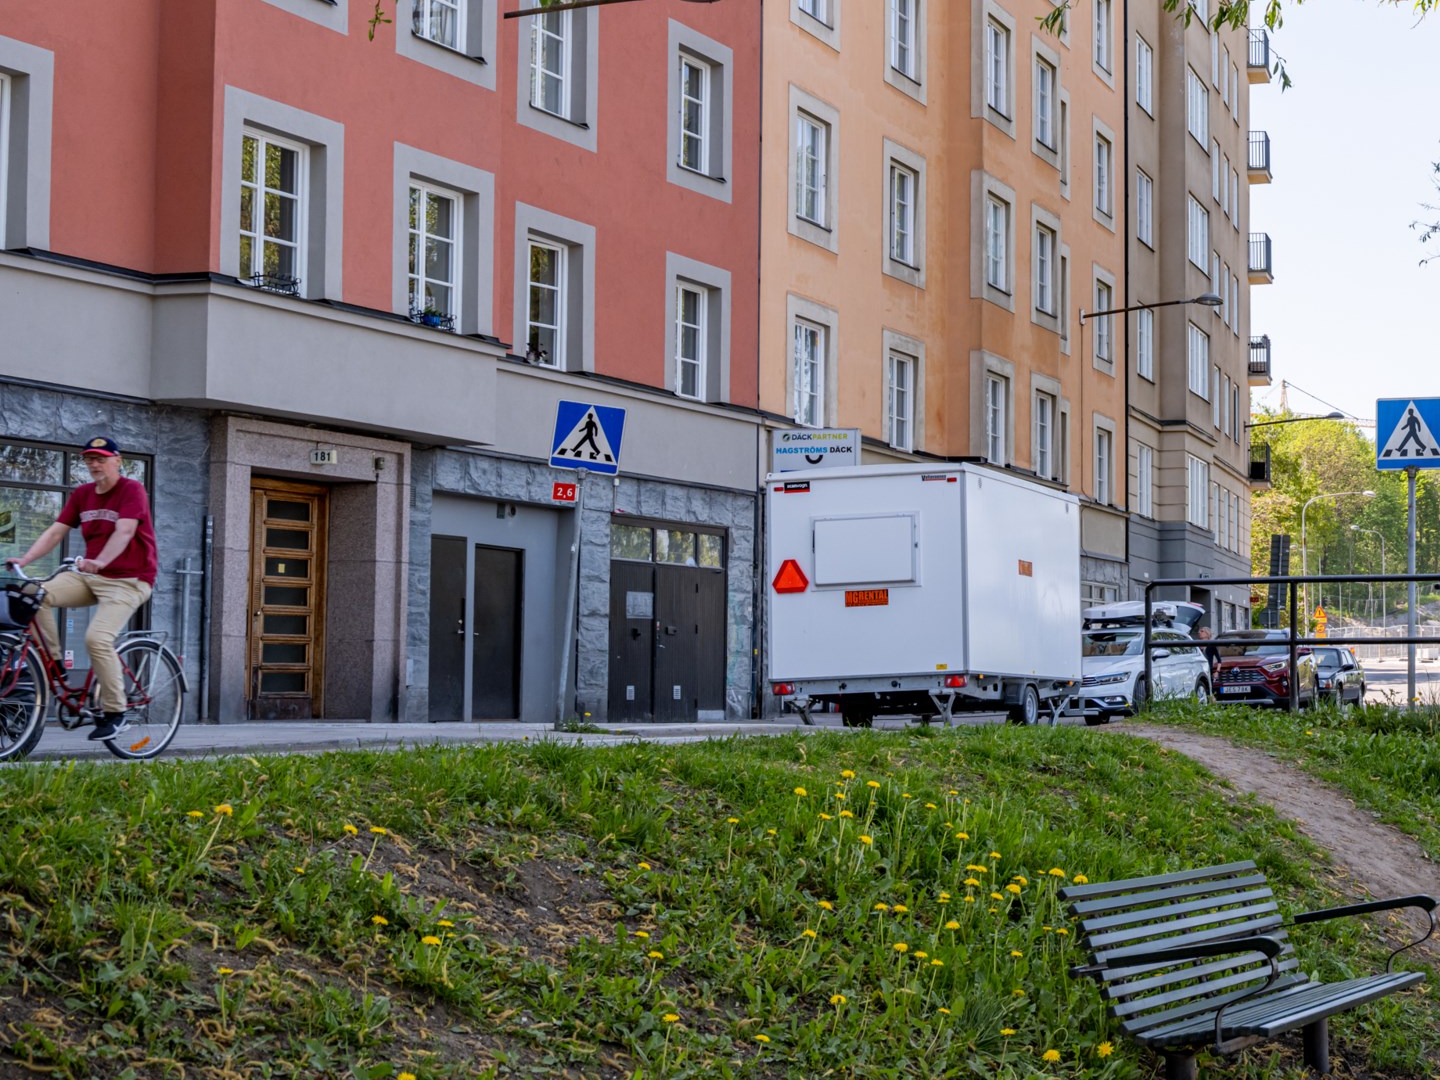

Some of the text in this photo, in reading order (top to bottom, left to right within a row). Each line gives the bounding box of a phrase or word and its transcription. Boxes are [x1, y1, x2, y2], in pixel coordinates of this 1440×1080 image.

[791, 433, 848, 441] DÄCKPARTNER
[776, 446, 828, 454] HAGSTRÖMS
[314, 451, 331, 462] 181
[557, 487, 573, 499] 2,6
